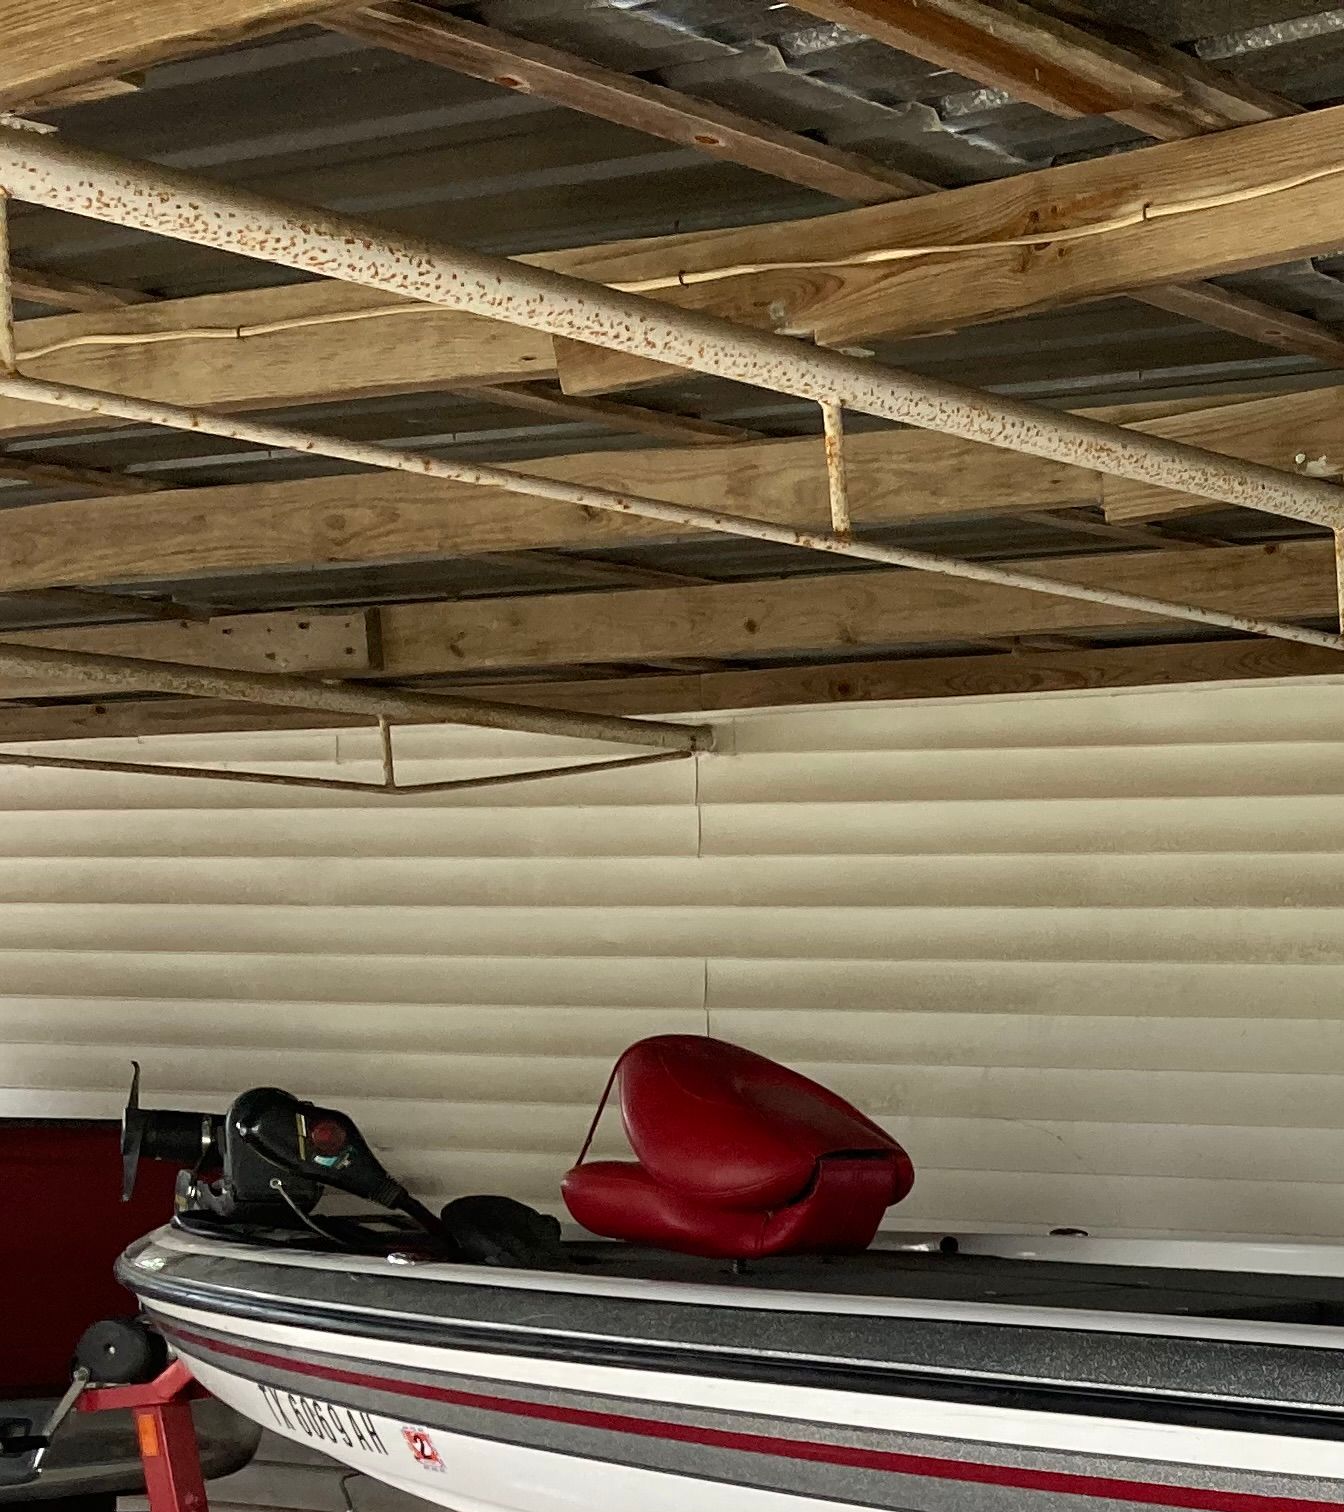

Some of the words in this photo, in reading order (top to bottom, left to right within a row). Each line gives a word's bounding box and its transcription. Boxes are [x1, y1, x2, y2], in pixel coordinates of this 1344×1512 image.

[258, 1384, 296, 1431] TX
[288, 1394, 353, 1447] 6069
[347, 1410, 389, 1456] AH
